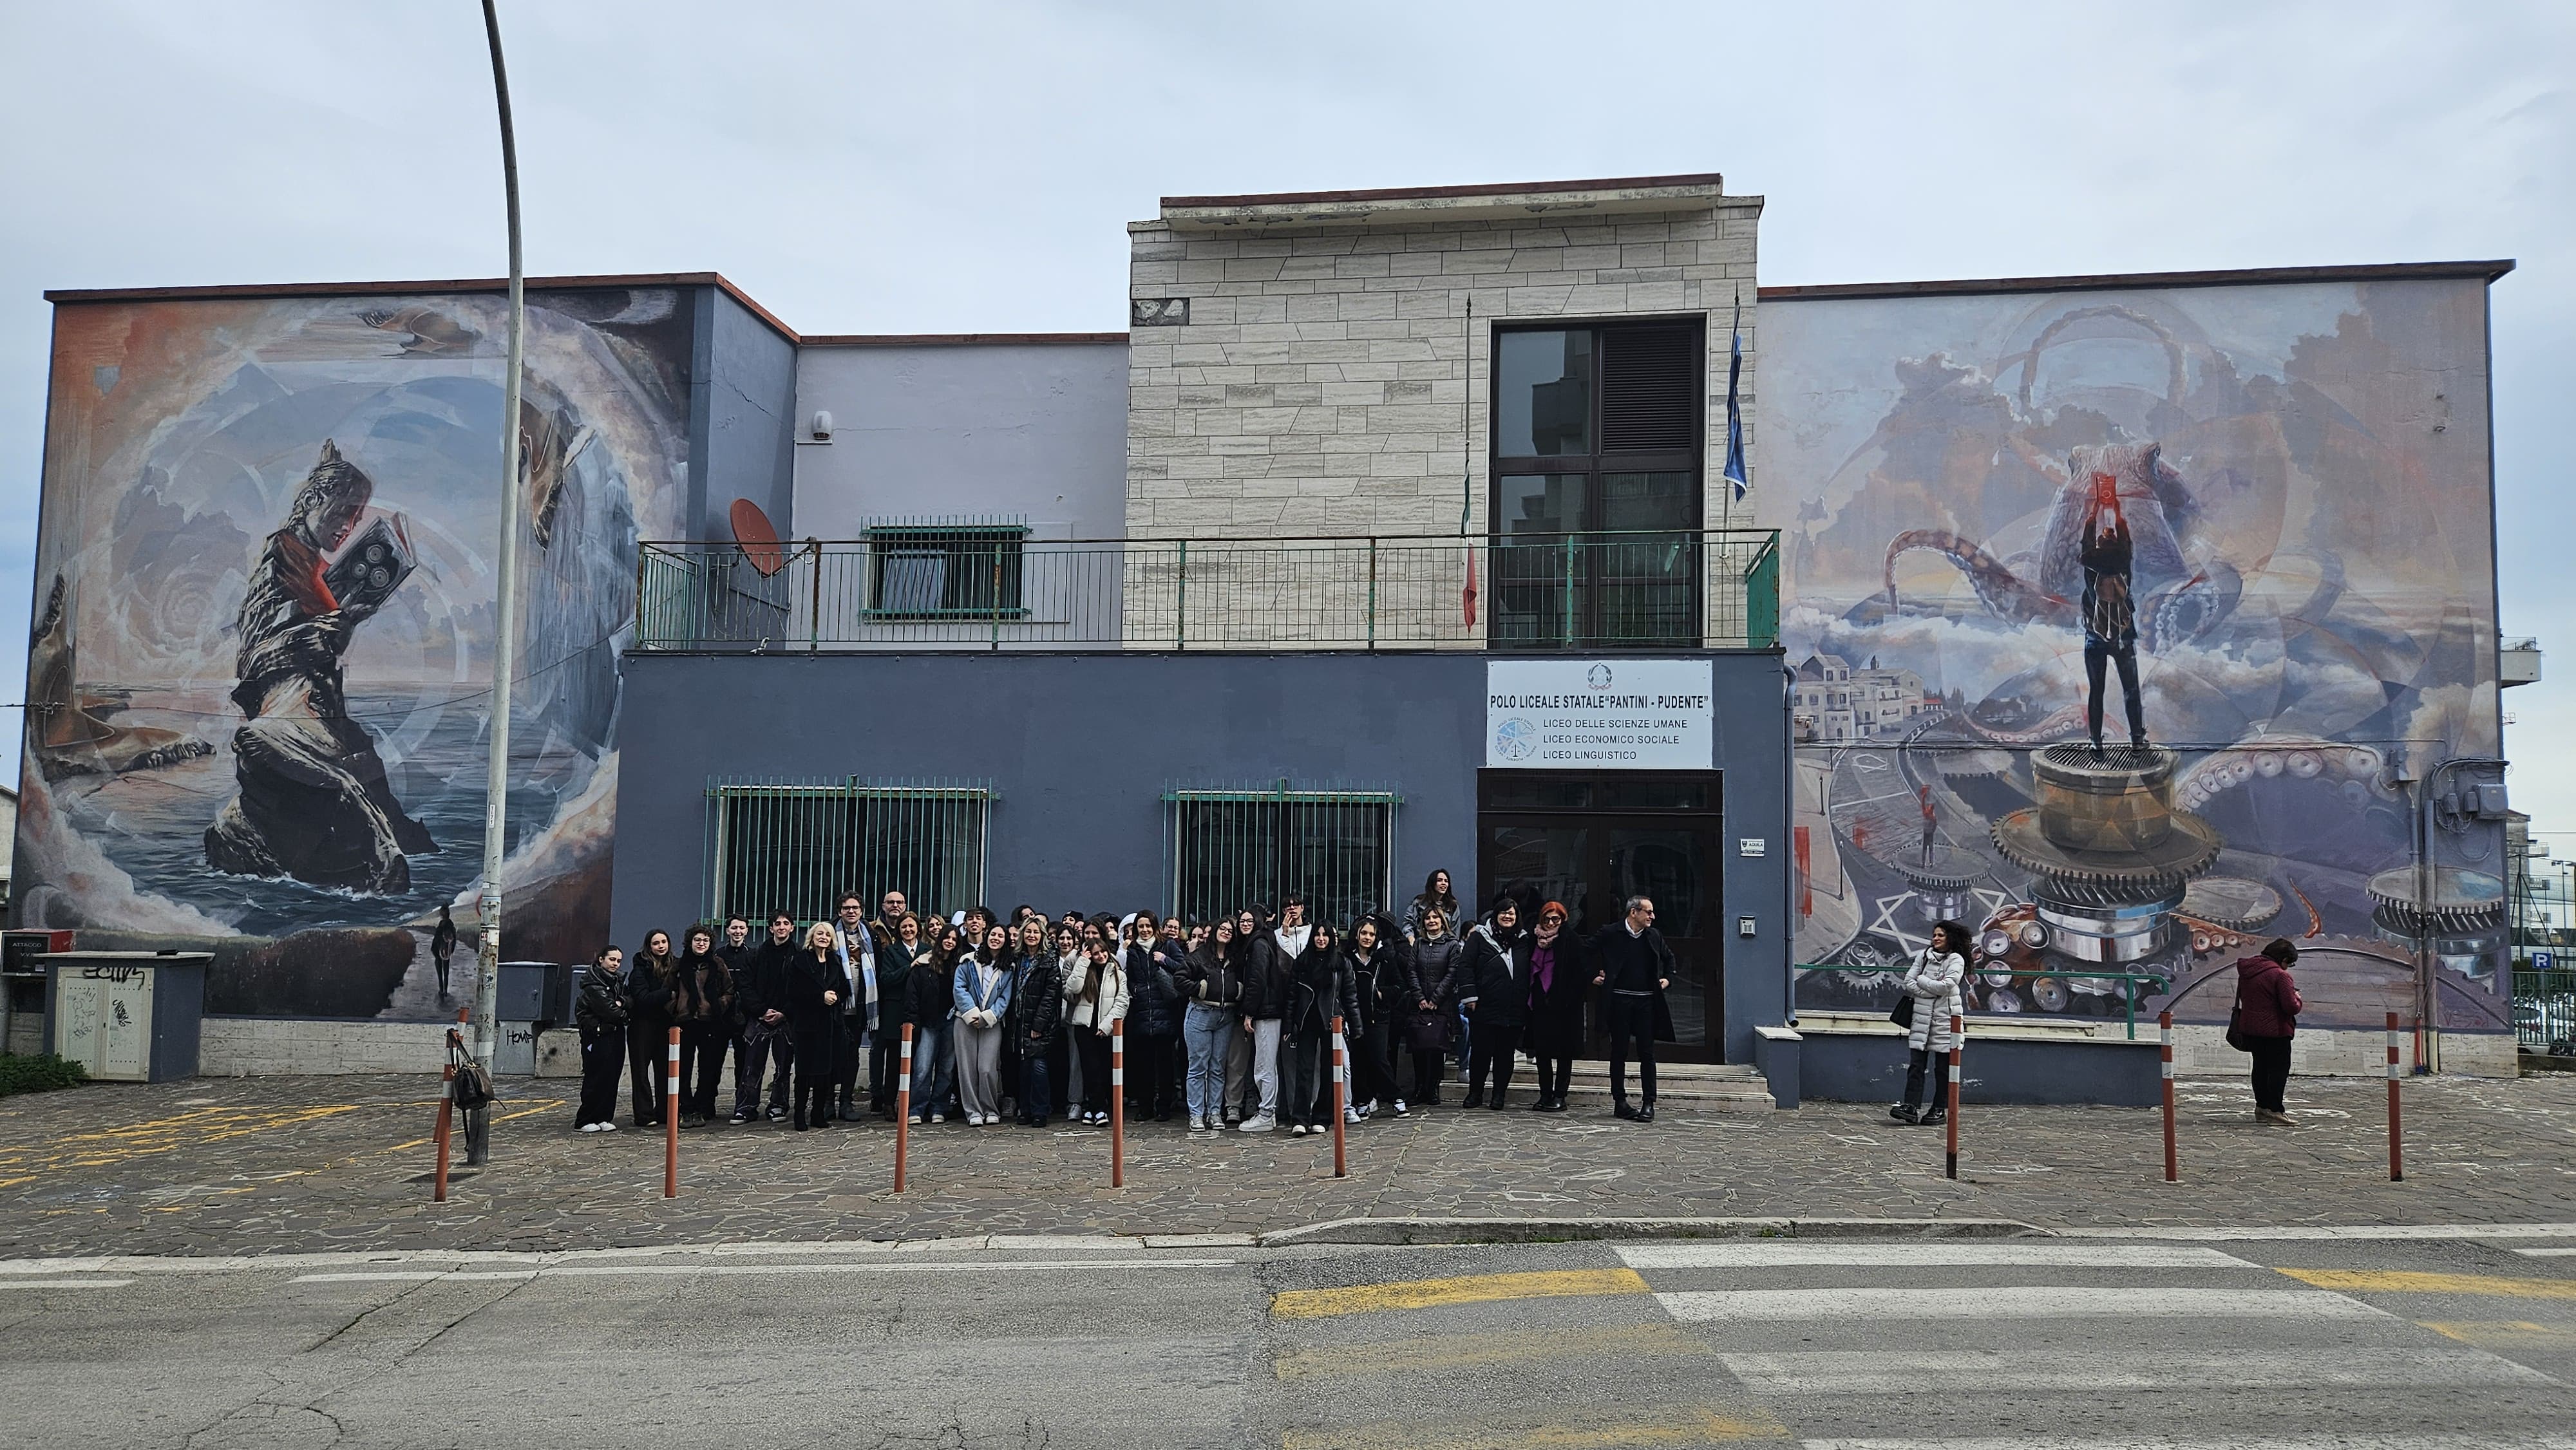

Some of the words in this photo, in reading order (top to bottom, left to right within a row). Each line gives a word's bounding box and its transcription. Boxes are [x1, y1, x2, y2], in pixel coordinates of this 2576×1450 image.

[1490, 695, 1516, 709] POLO
[1520, 695, 1560, 709] LICEALE
[1544, 719, 1572, 728] LICEO
[1575, 719, 1605, 728] DELLE
[1609, 719, 1650, 728] SCIENZE
[1653, 719, 1688, 728] UMANE
[1543, 735, 1571, 743] LICEO
[1575, 735, 1634, 744] ECONOMICO
[1637, 735, 1680, 744] SOCIALE
[1543, 751, 1571, 759] LICEO
[1575, 751, 1637, 760] LINGUISTICO
